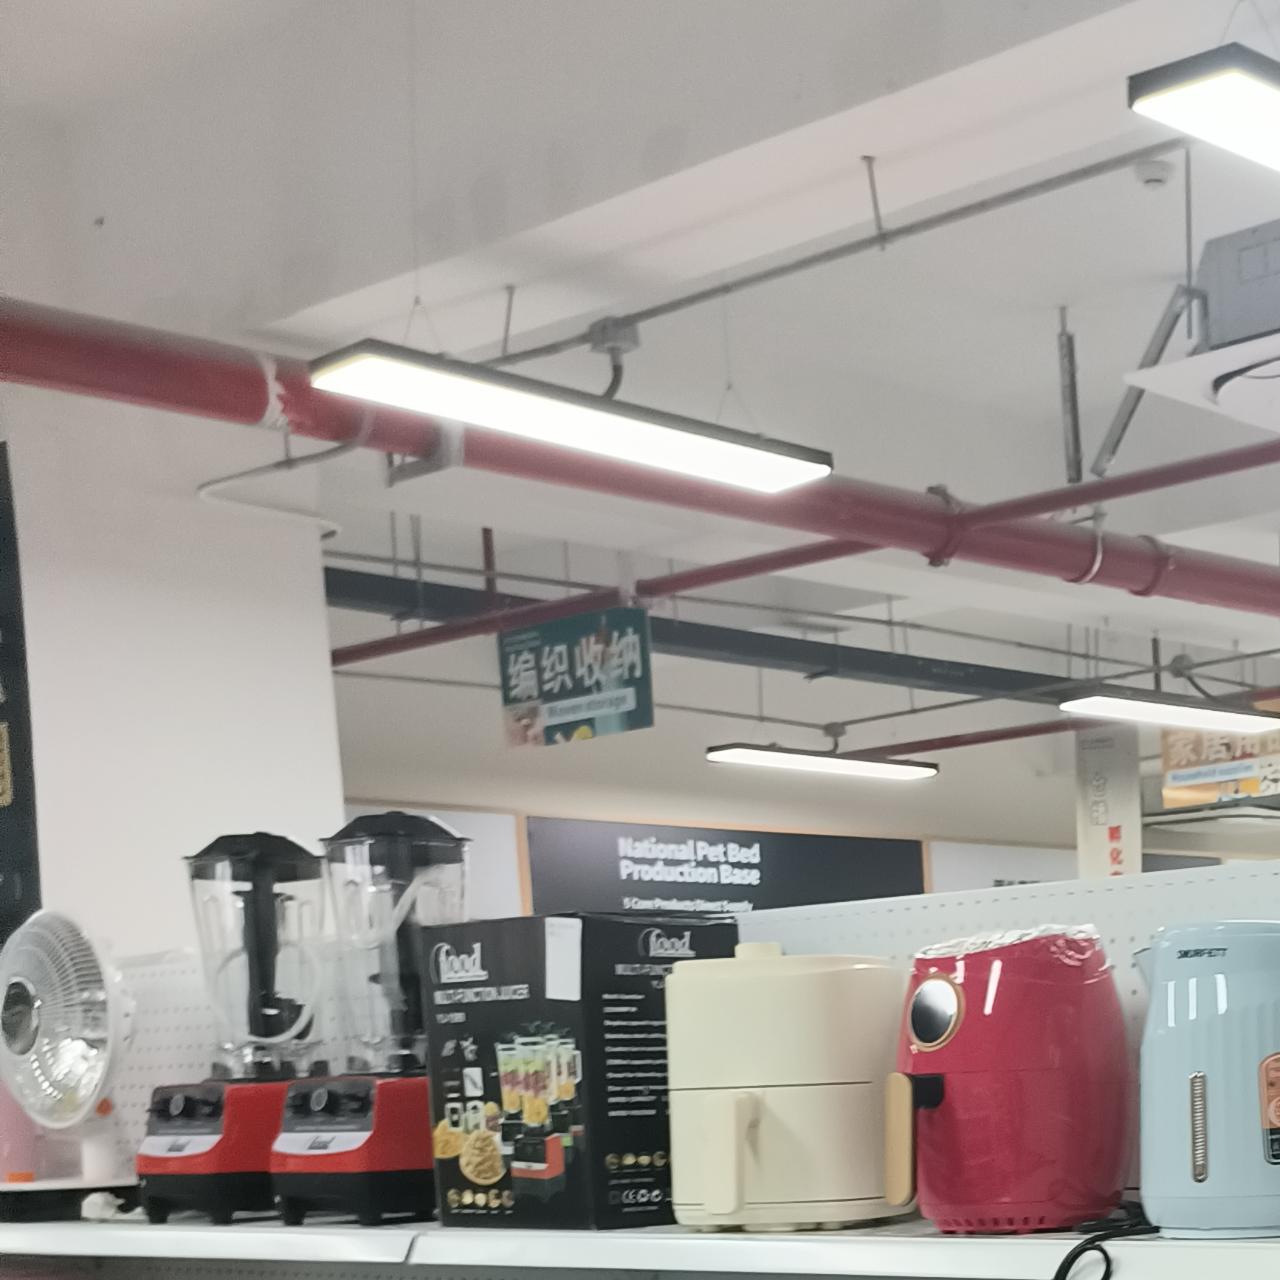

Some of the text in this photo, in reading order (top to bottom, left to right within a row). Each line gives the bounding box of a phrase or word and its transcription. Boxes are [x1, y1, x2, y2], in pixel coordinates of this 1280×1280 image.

[508, 628, 643, 699] 编织收纳
[618, 836, 761, 864] National Pet Bed
[619, 859, 761, 886] Production Base
